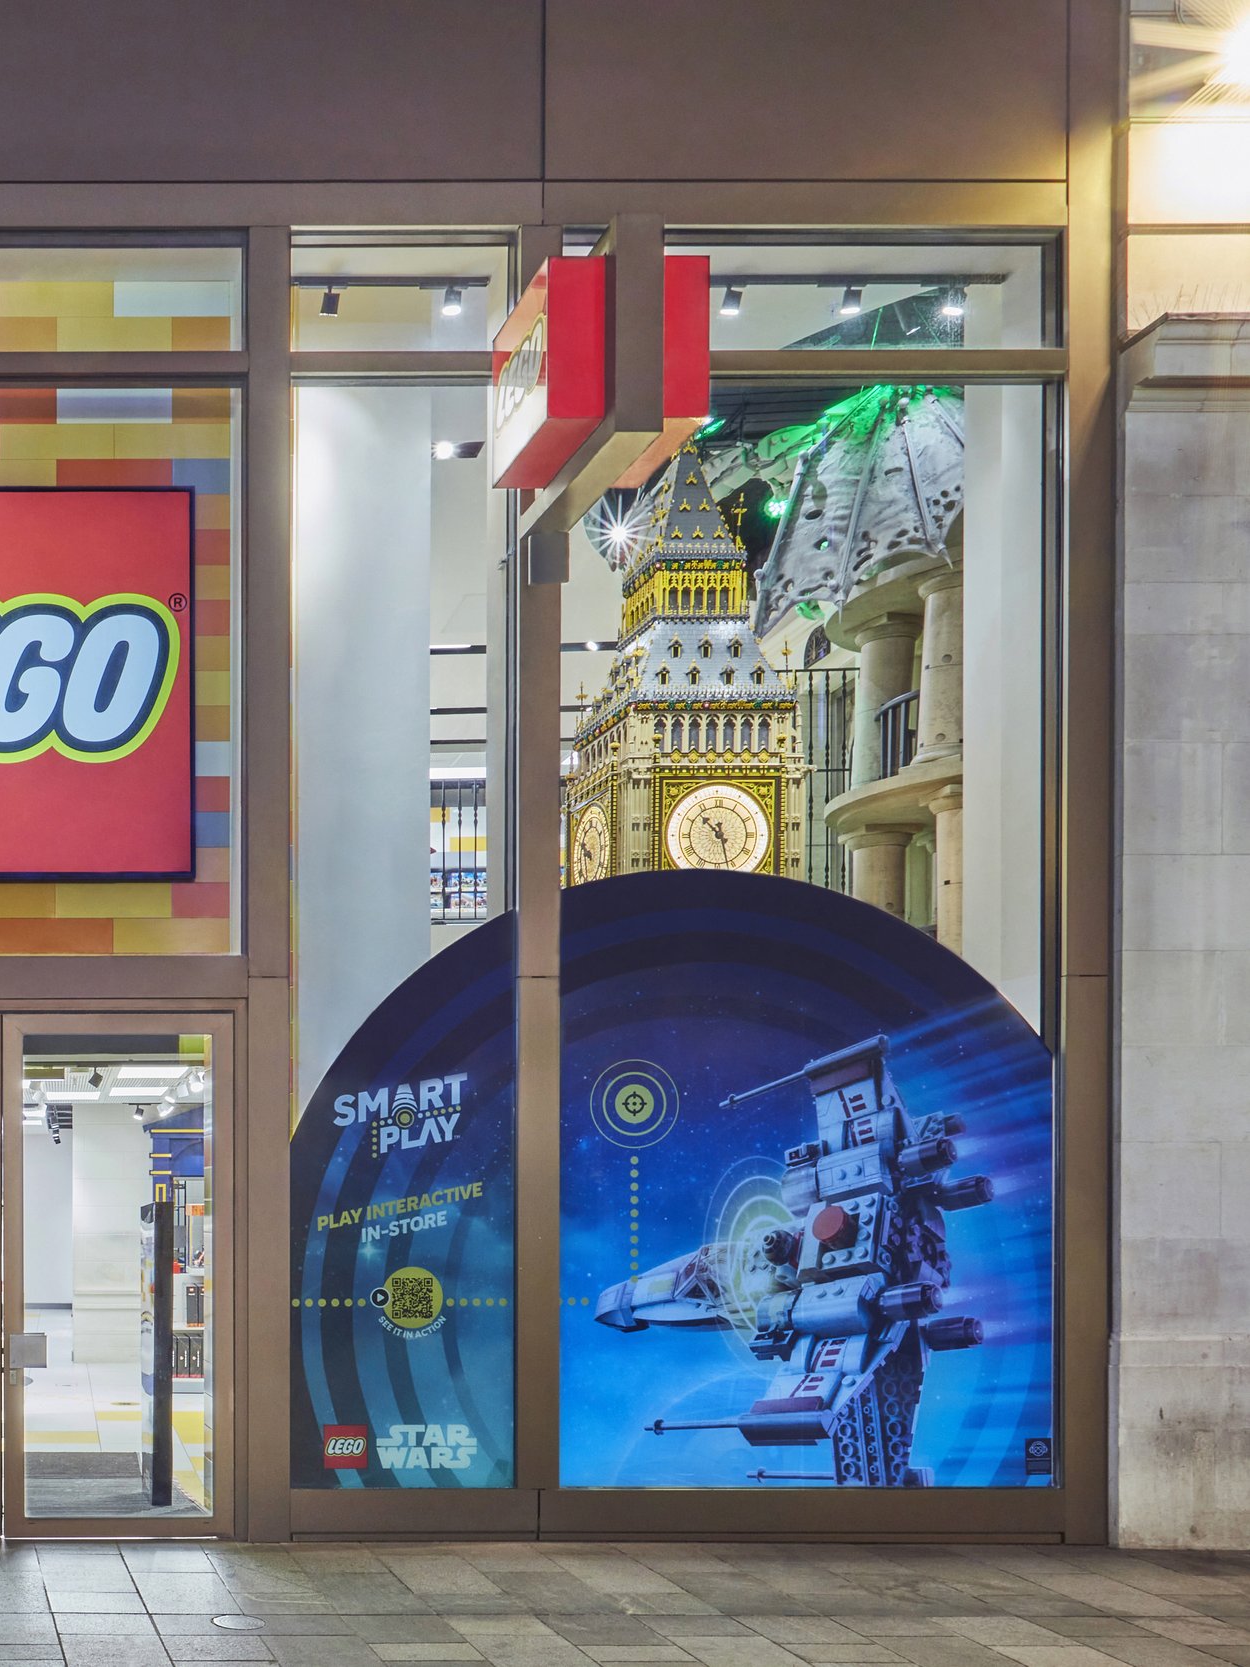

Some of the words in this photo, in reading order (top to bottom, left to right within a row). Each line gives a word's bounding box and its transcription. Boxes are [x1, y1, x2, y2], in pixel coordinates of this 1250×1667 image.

[333, 1072, 468, 1127] SMART
[379, 1112, 461, 1154] PLAY
[317, 1207, 363, 1231] PLAY
[366, 1181, 483, 1220] INTERACTIVE
[360, 1210, 448, 1243] IN-STORE
[378, 1315, 394, 1332] SEE
[393, 1328, 403, 1336] IT
[403, 1330, 414, 1339] IN
[414, 1315, 447, 1339] ACTION
[325, 1436, 366, 1456] LEGO
[376, 1424, 478, 1447] STAR
[376, 1447, 478, 1469] WARS
